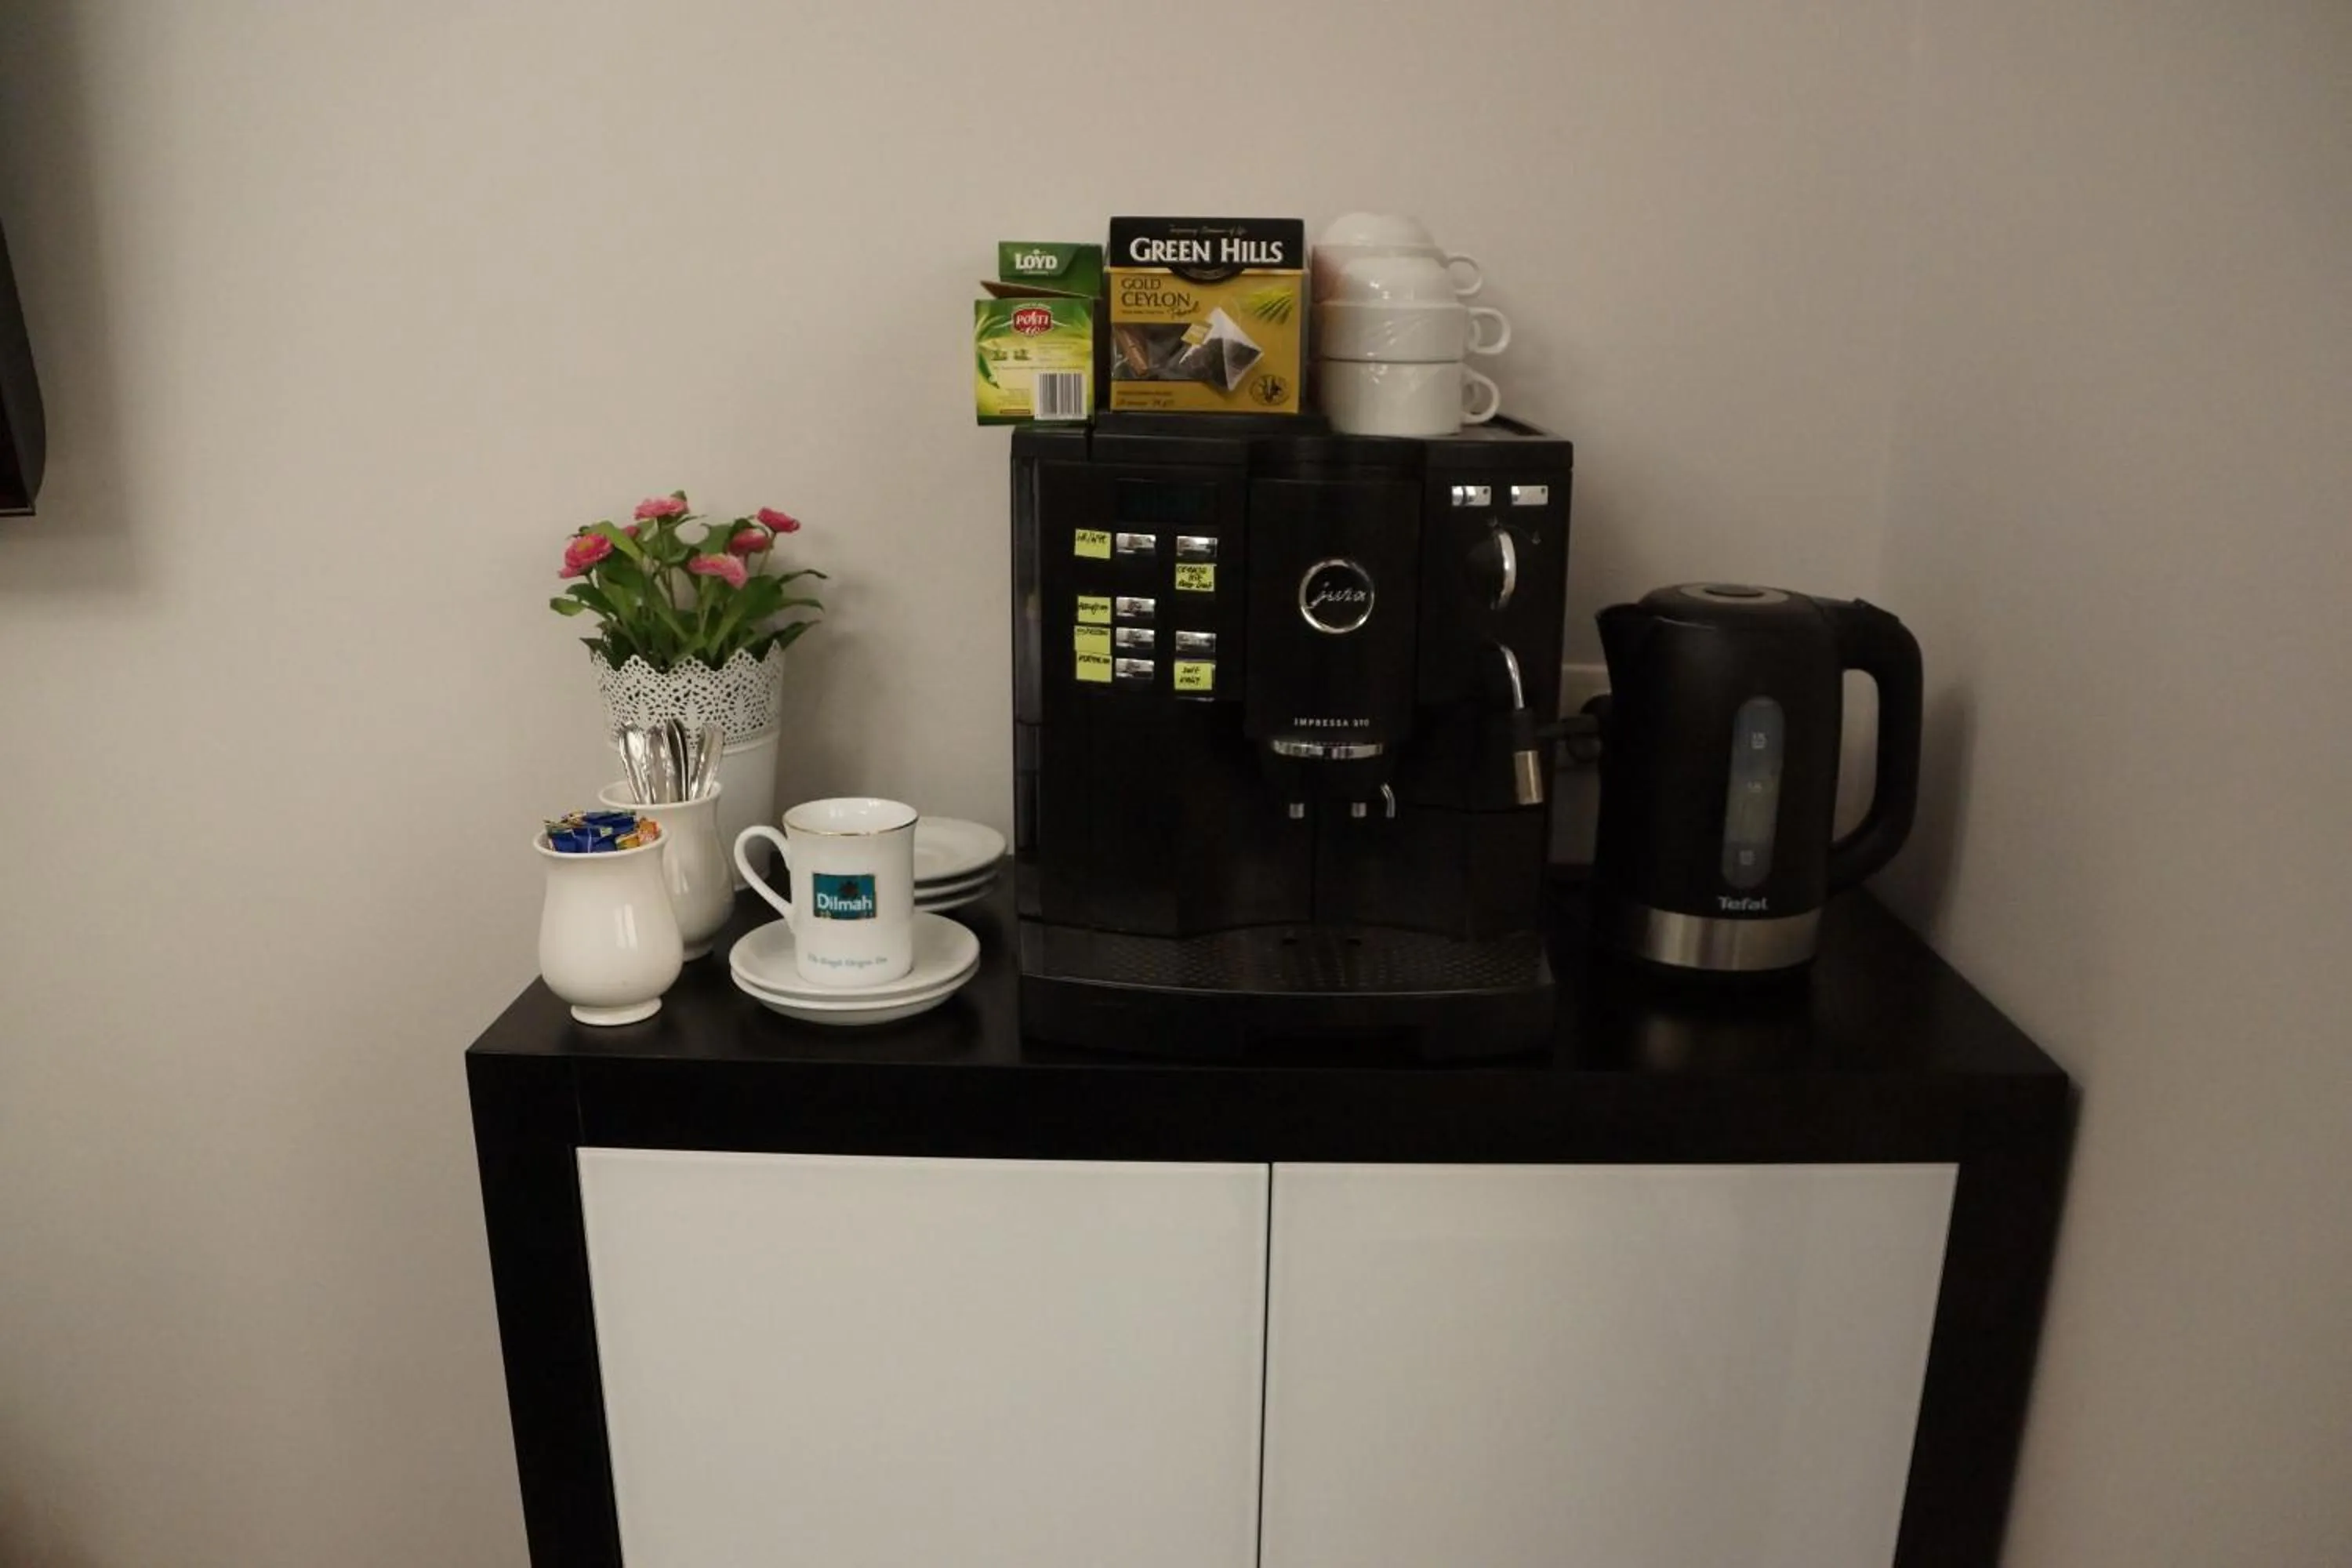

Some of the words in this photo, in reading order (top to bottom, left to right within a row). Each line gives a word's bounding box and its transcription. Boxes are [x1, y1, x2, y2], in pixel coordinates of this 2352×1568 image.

[1129, 237, 1210, 263] GREEN
[1220, 237, 1283, 263] HILLS
[1014, 251, 1058, 270] LOYD
[1121, 278, 1161, 289] GOLD
[1121, 291, 1191, 307] CEYLON
[1294, 717, 1349, 728] IMPRESSA
[816, 892, 873, 911] Dilmah
[1718, 897, 1769, 910] Tefal
